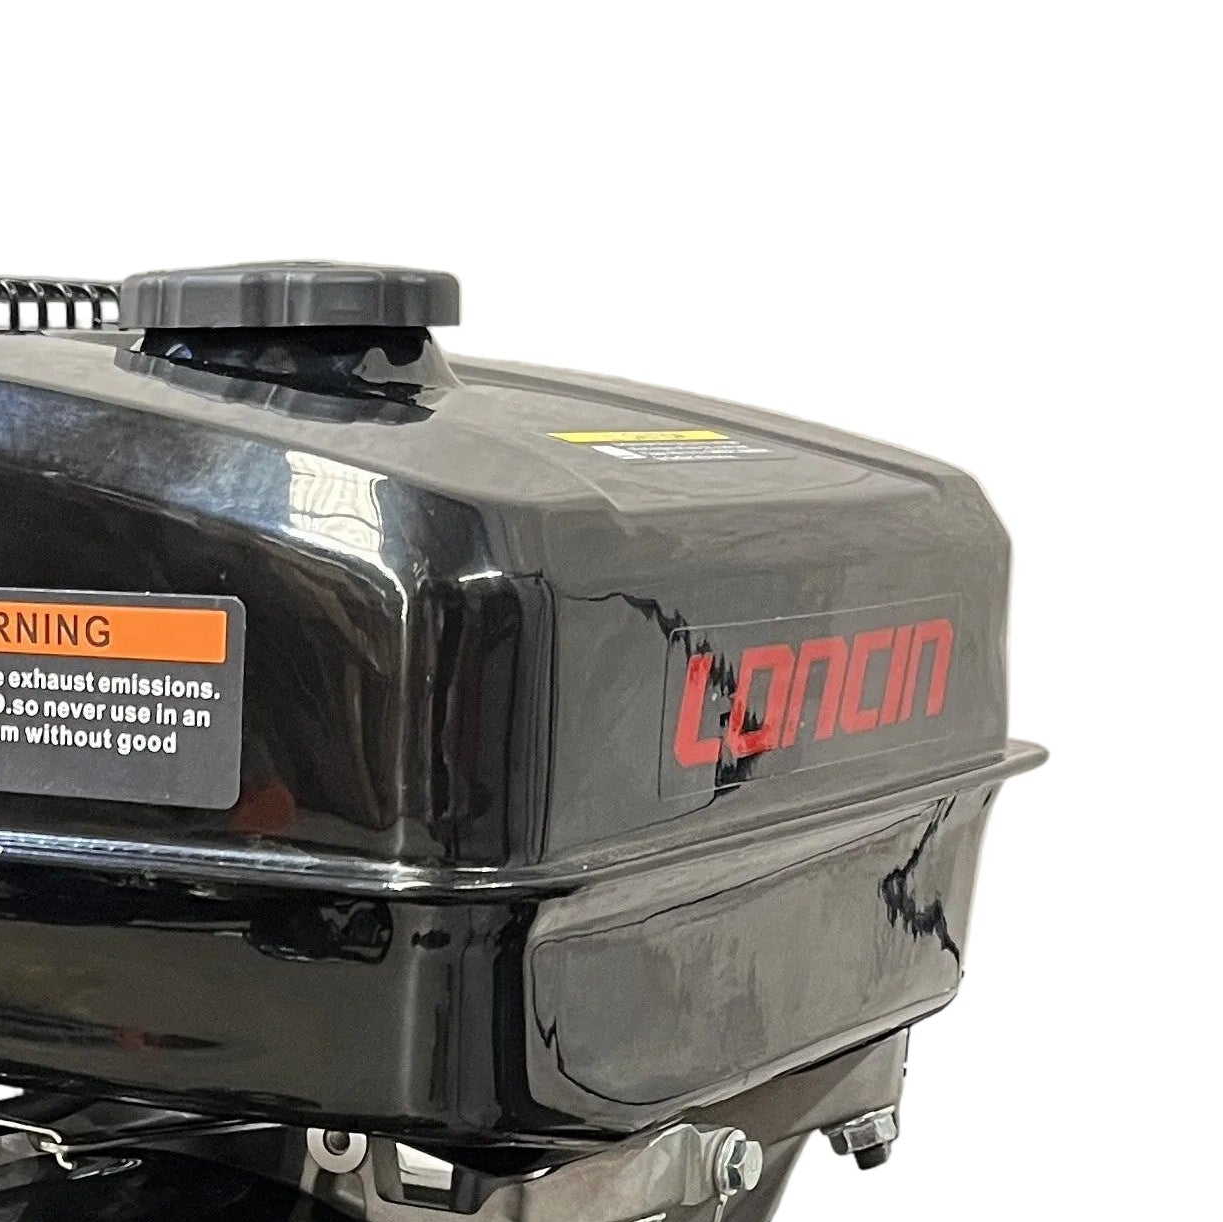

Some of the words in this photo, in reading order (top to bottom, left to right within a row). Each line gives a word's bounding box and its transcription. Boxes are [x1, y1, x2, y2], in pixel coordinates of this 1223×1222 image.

[8, 667, 95, 693] exhaust
[674, 618, 953, 768] LONCIN
[43, 699, 106, 721] never
[110, 703, 151, 724] use
[156, 702, 177, 726] in
[182, 708, 211, 728] an
[25, 723, 113, 749] without
[117, 731, 177, 755] good
